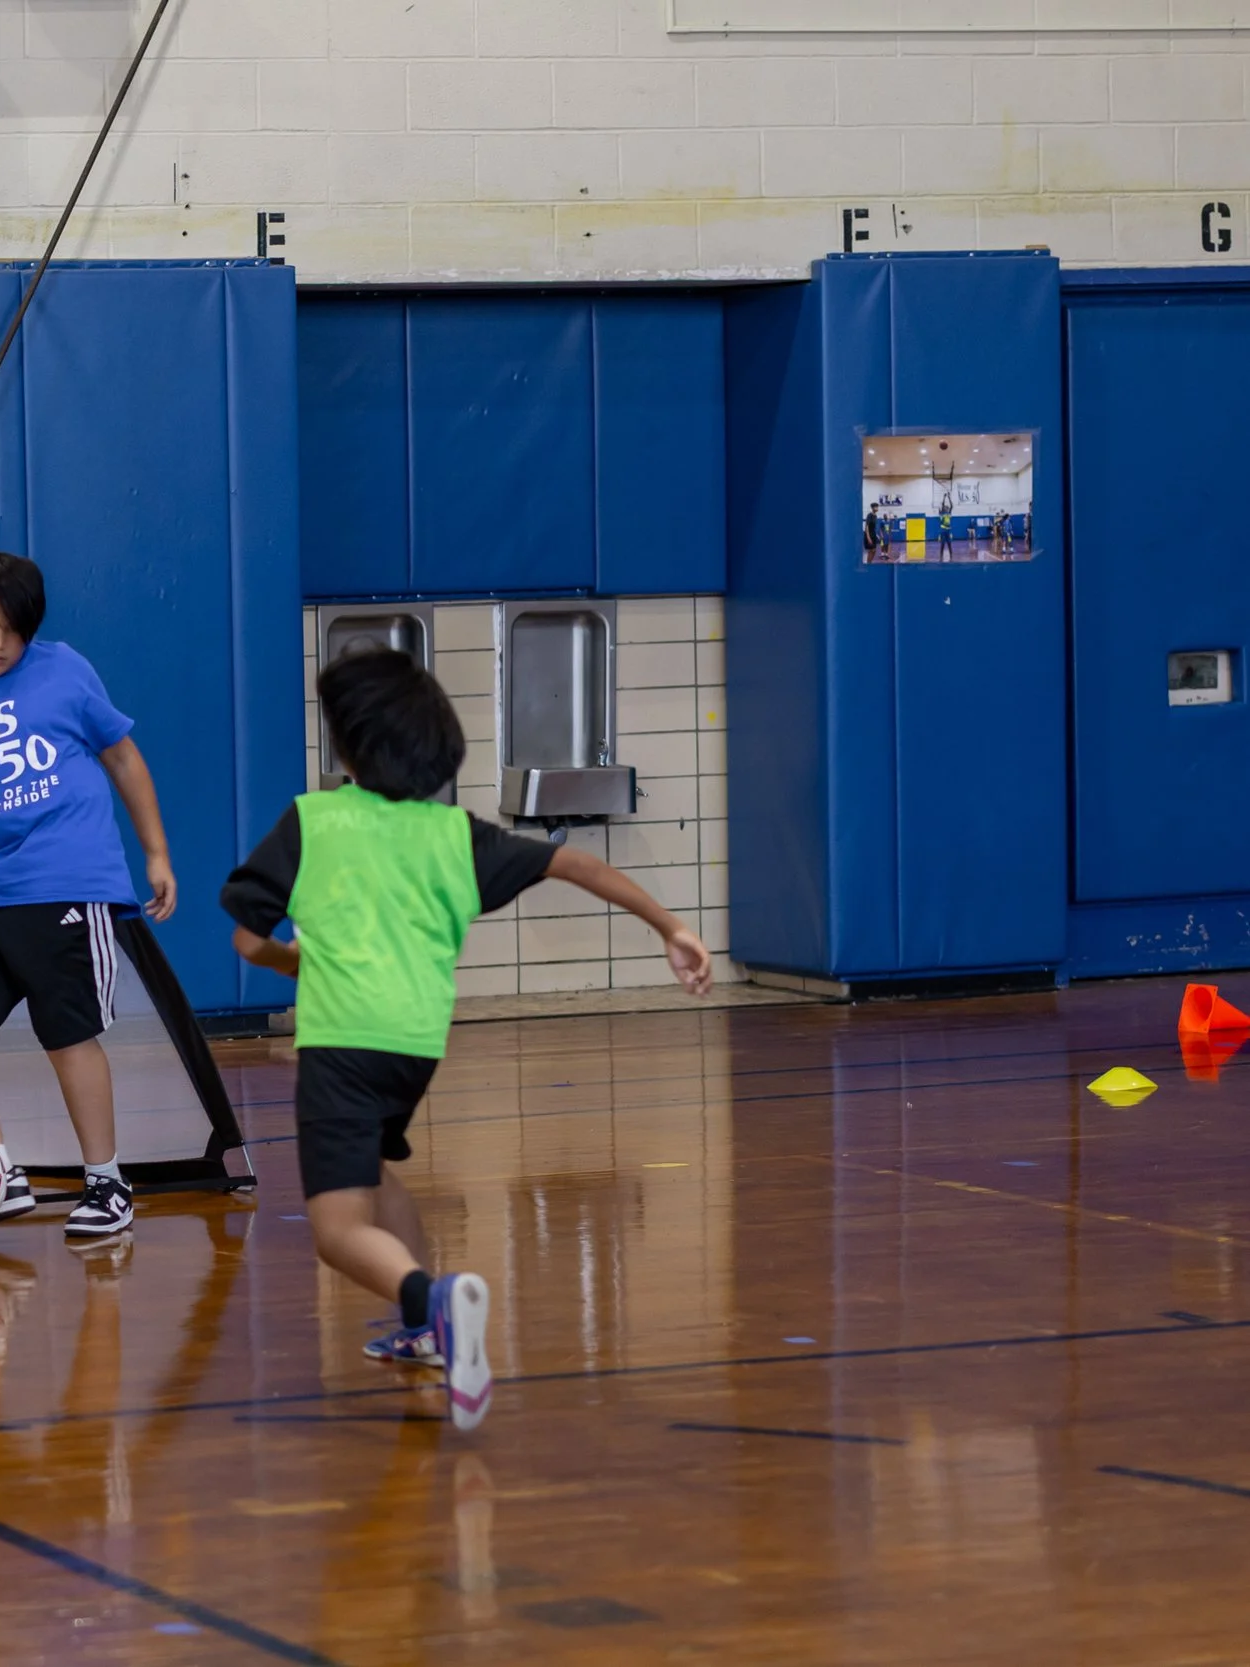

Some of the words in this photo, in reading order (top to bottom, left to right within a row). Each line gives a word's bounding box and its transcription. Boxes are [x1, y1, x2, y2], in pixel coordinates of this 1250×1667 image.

[257, 212, 285, 265] E
[843, 208, 869, 252] F
[1201, 202, 1231, 252] G
[4, 785, 23, 800] OF
[30, 774, 60, 792] THE
